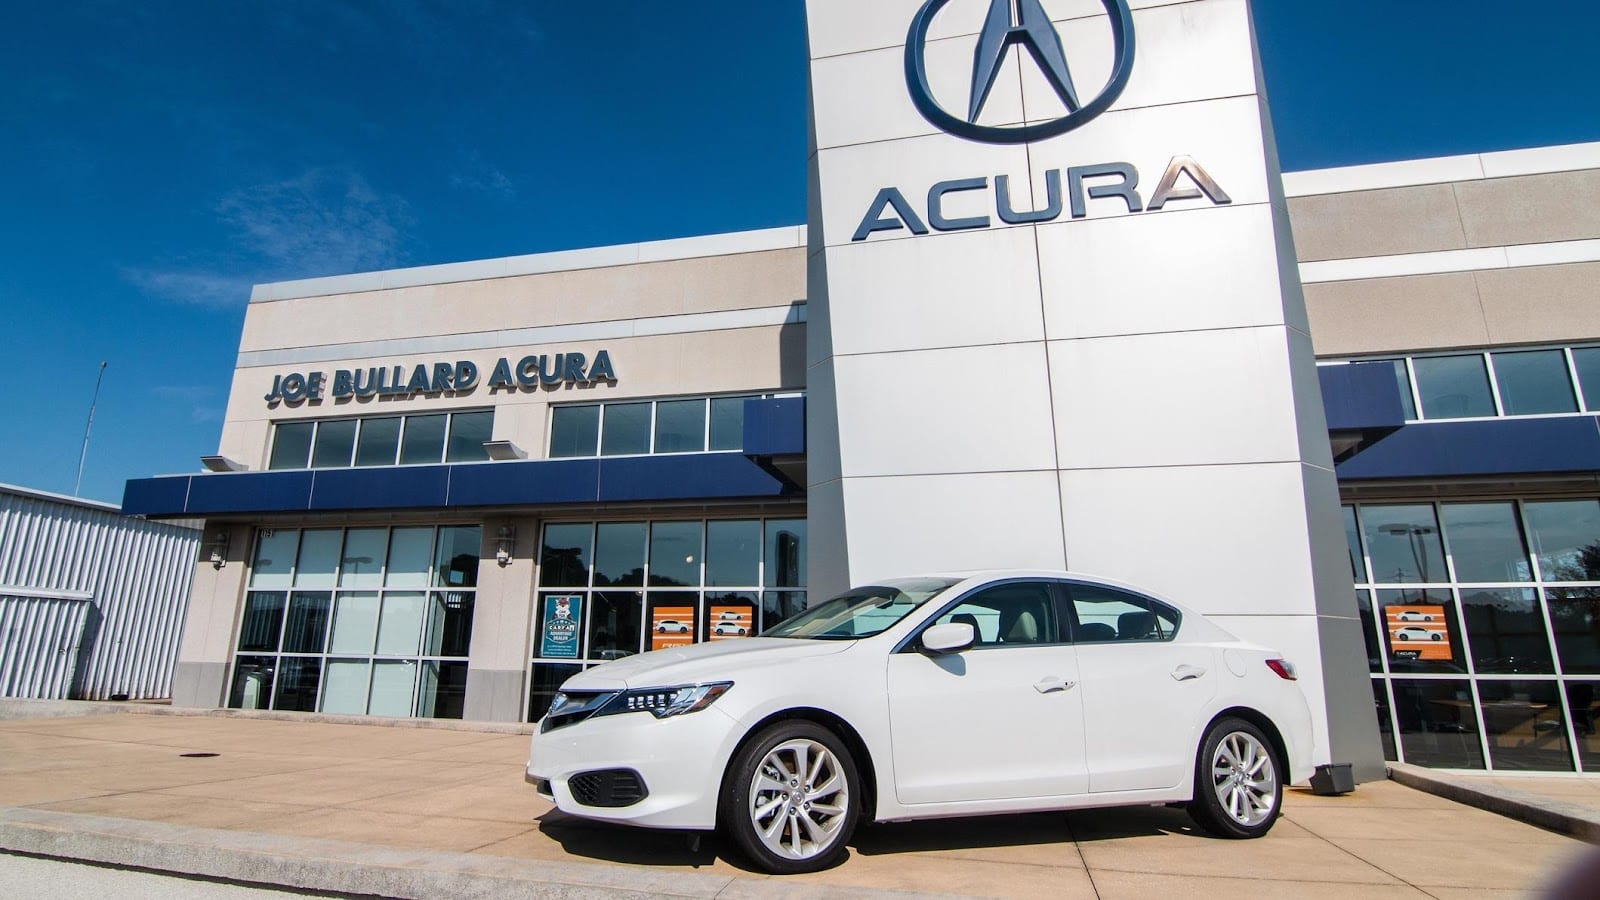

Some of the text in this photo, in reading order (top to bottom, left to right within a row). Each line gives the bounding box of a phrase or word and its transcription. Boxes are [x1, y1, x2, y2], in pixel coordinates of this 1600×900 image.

[852, 154, 1232, 241] ACURA
[265, 350, 617, 405] JOE BULLARD ACURA
